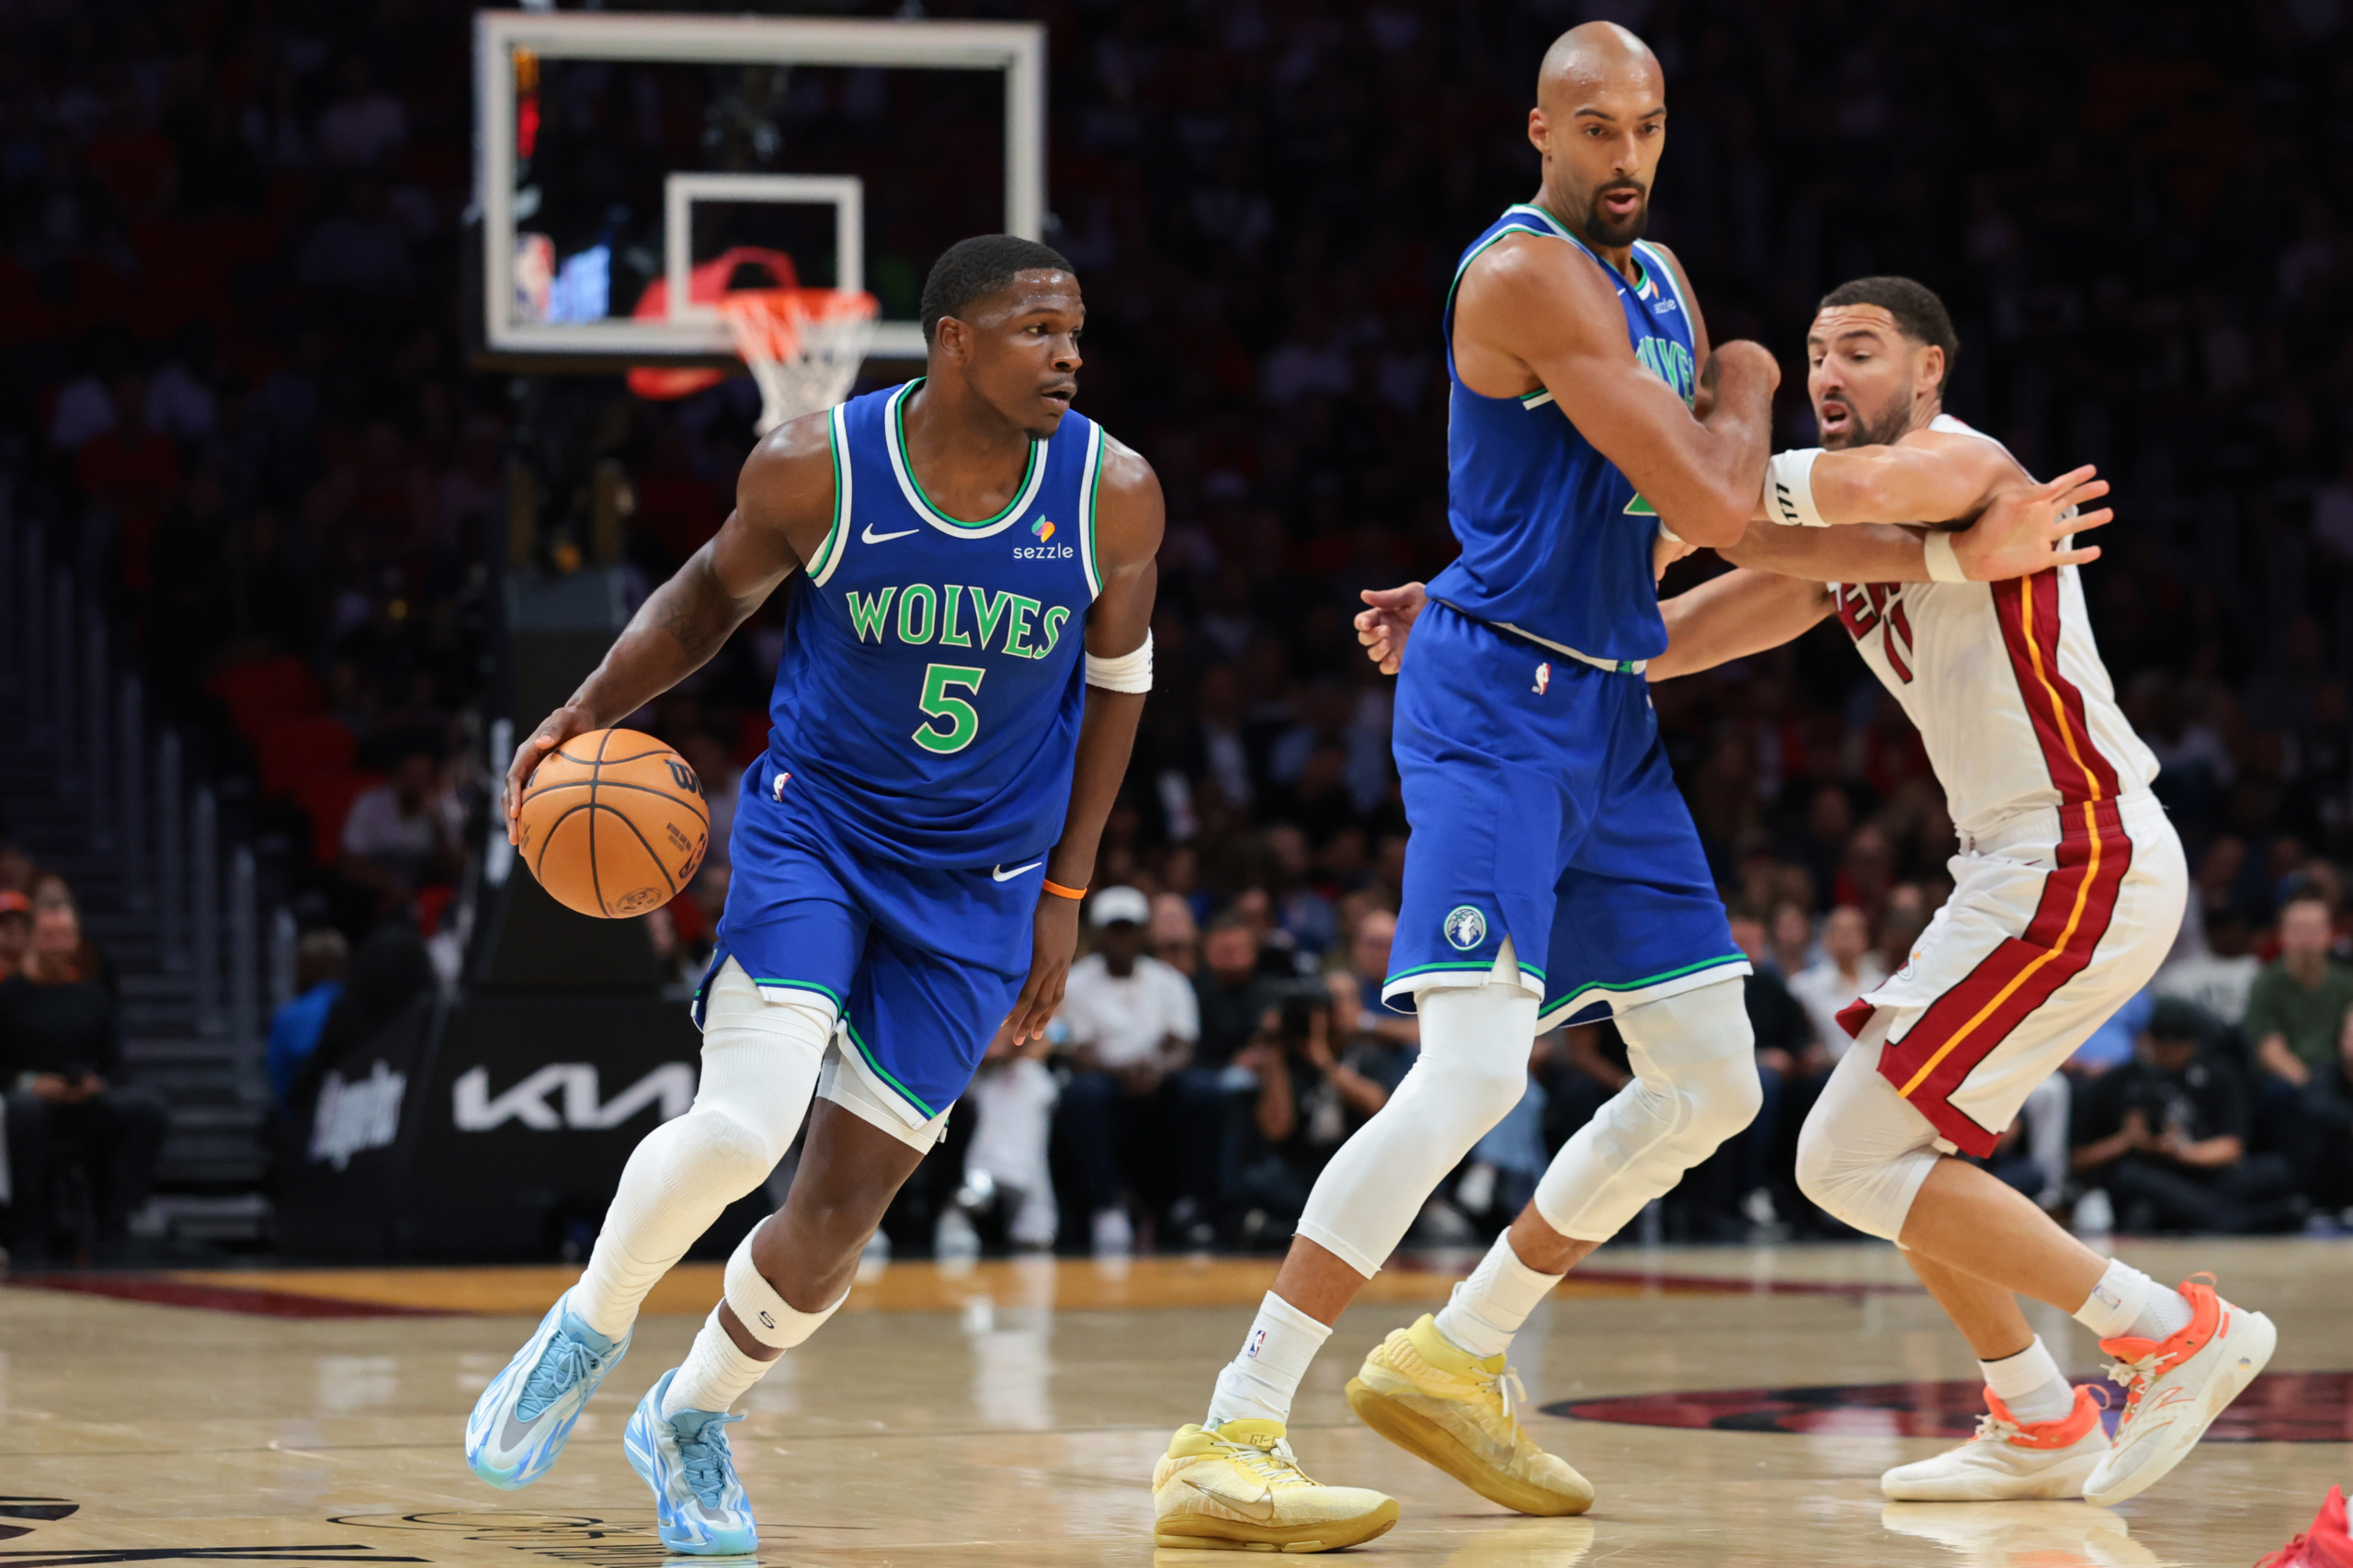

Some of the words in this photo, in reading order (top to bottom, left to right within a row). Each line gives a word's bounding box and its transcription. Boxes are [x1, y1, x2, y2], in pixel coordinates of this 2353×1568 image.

[1013, 542, 1074, 560] sezzle
[846, 583, 1071, 660] WOLVES
[911, 663, 986, 755] 5
